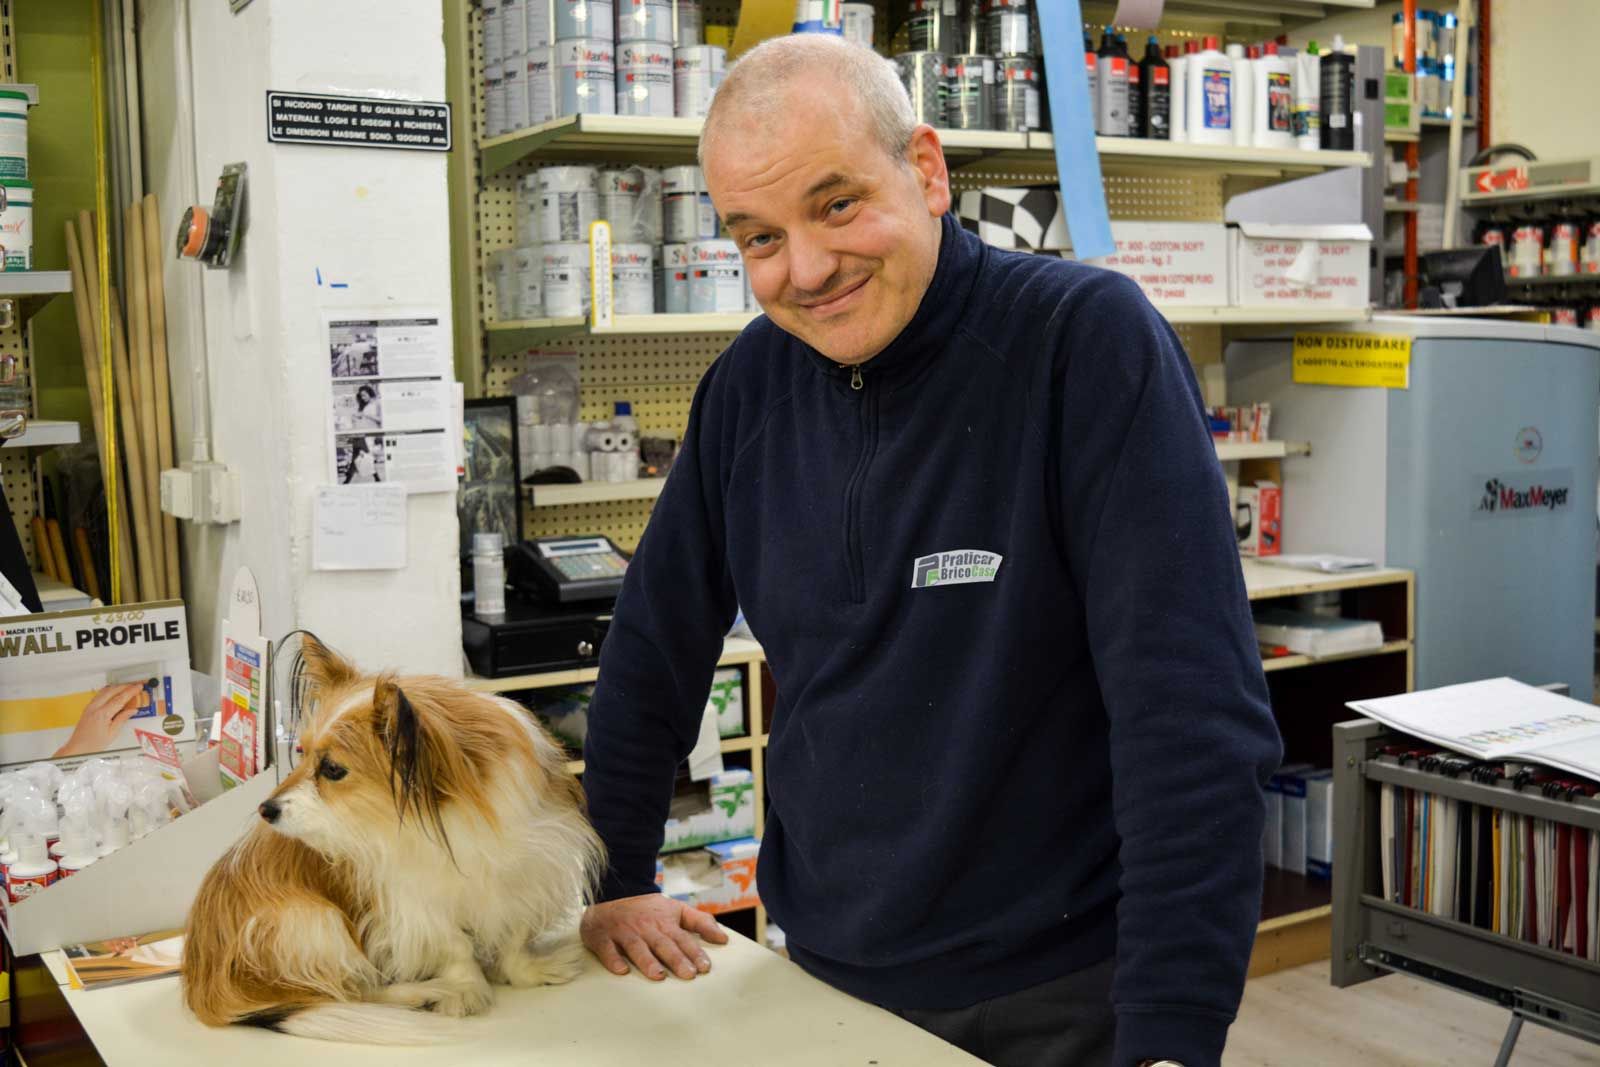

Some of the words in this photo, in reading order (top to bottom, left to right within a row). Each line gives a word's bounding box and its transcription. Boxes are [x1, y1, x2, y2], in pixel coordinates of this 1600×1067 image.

[272, 99, 281, 108] SI
[284, 100, 324, 110] INCIDONO
[326, 102, 357, 112] TARGHE
[360, 104, 372, 113] SU
[375, 105, 415, 116] QUALSIASI
[417, 108, 435, 117] TIPO
[438, 109, 446, 118] DI
[324, 116, 348, 125] LOGHI
[351, 118, 357, 126] E
[360, 118, 391, 128] DISEGNI
[393, 120, 400, 128] A
[272, 126, 282, 135] LE
[286, 127, 330, 137] DIMENSIONI
[332, 129, 367, 140] MASSIME
[1296, 336, 1322, 349] NON
[1326, 336, 1407, 351] DISTURBARE
[1499, 485, 1568, 511] MaxMeyer
[941, 552, 995, 568] Praticar
[941, 565, 997, 580] BricoCasa
[6, 628, 26, 636] MADE
[35, 625, 54, 633] ITALY
[76, 620, 180, 649] PROFILE
